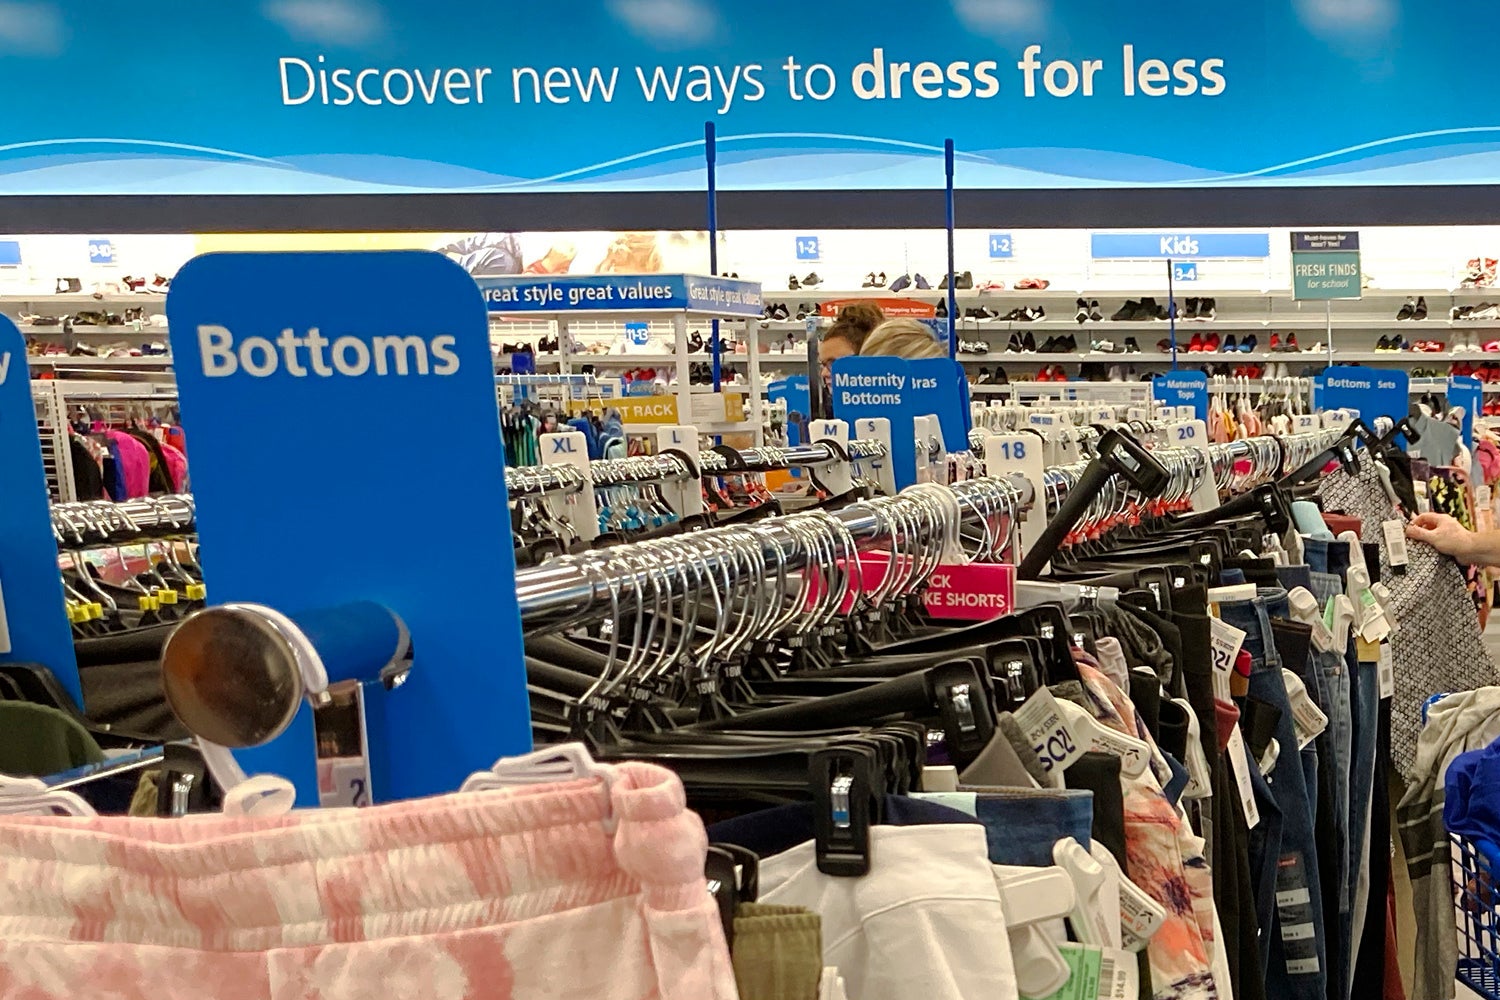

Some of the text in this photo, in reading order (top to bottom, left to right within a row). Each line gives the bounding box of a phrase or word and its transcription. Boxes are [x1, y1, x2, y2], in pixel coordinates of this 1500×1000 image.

[279, 44, 1227, 115] Discover new ways to dress for less
[798, 240, 817, 254] 1-2
[991, 239, 1010, 252] 1-2
[1160, 236, 1199, 255] Kids
[1175, 267, 1196, 281] 3-4
[1296, 264, 1357, 277] FRESH FINDS
[690, 282, 708, 300] Great
[1307, 279, 1349, 289] for school
[484, 282, 672, 305] reat style great values
[626, 327, 649, 341] 11-13
[197, 325, 461, 379] Bottoms
[835, 372, 906, 390] Maternity
[1167, 379, 1206, 391] Maternity
[1327, 377, 1371, 390] Bottoms
[1377, 380, 1397, 390] Sets
[842, 391, 902, 406] Bottoms
[1178, 390, 1196, 400] Tops
[633, 404, 673, 417] RACK
[1332, 412, 1344, 421] 24
[869, 421, 876, 432] S
[1300, 418, 1311, 426] 22
[672, 430, 681, 444] L
[824, 424, 837, 436] M
[1177, 426, 1195, 440] 20
[553, 437, 577, 453] XL
[1001, 441, 1026, 460] 18
[946, 593, 1006, 608] SHORTS
